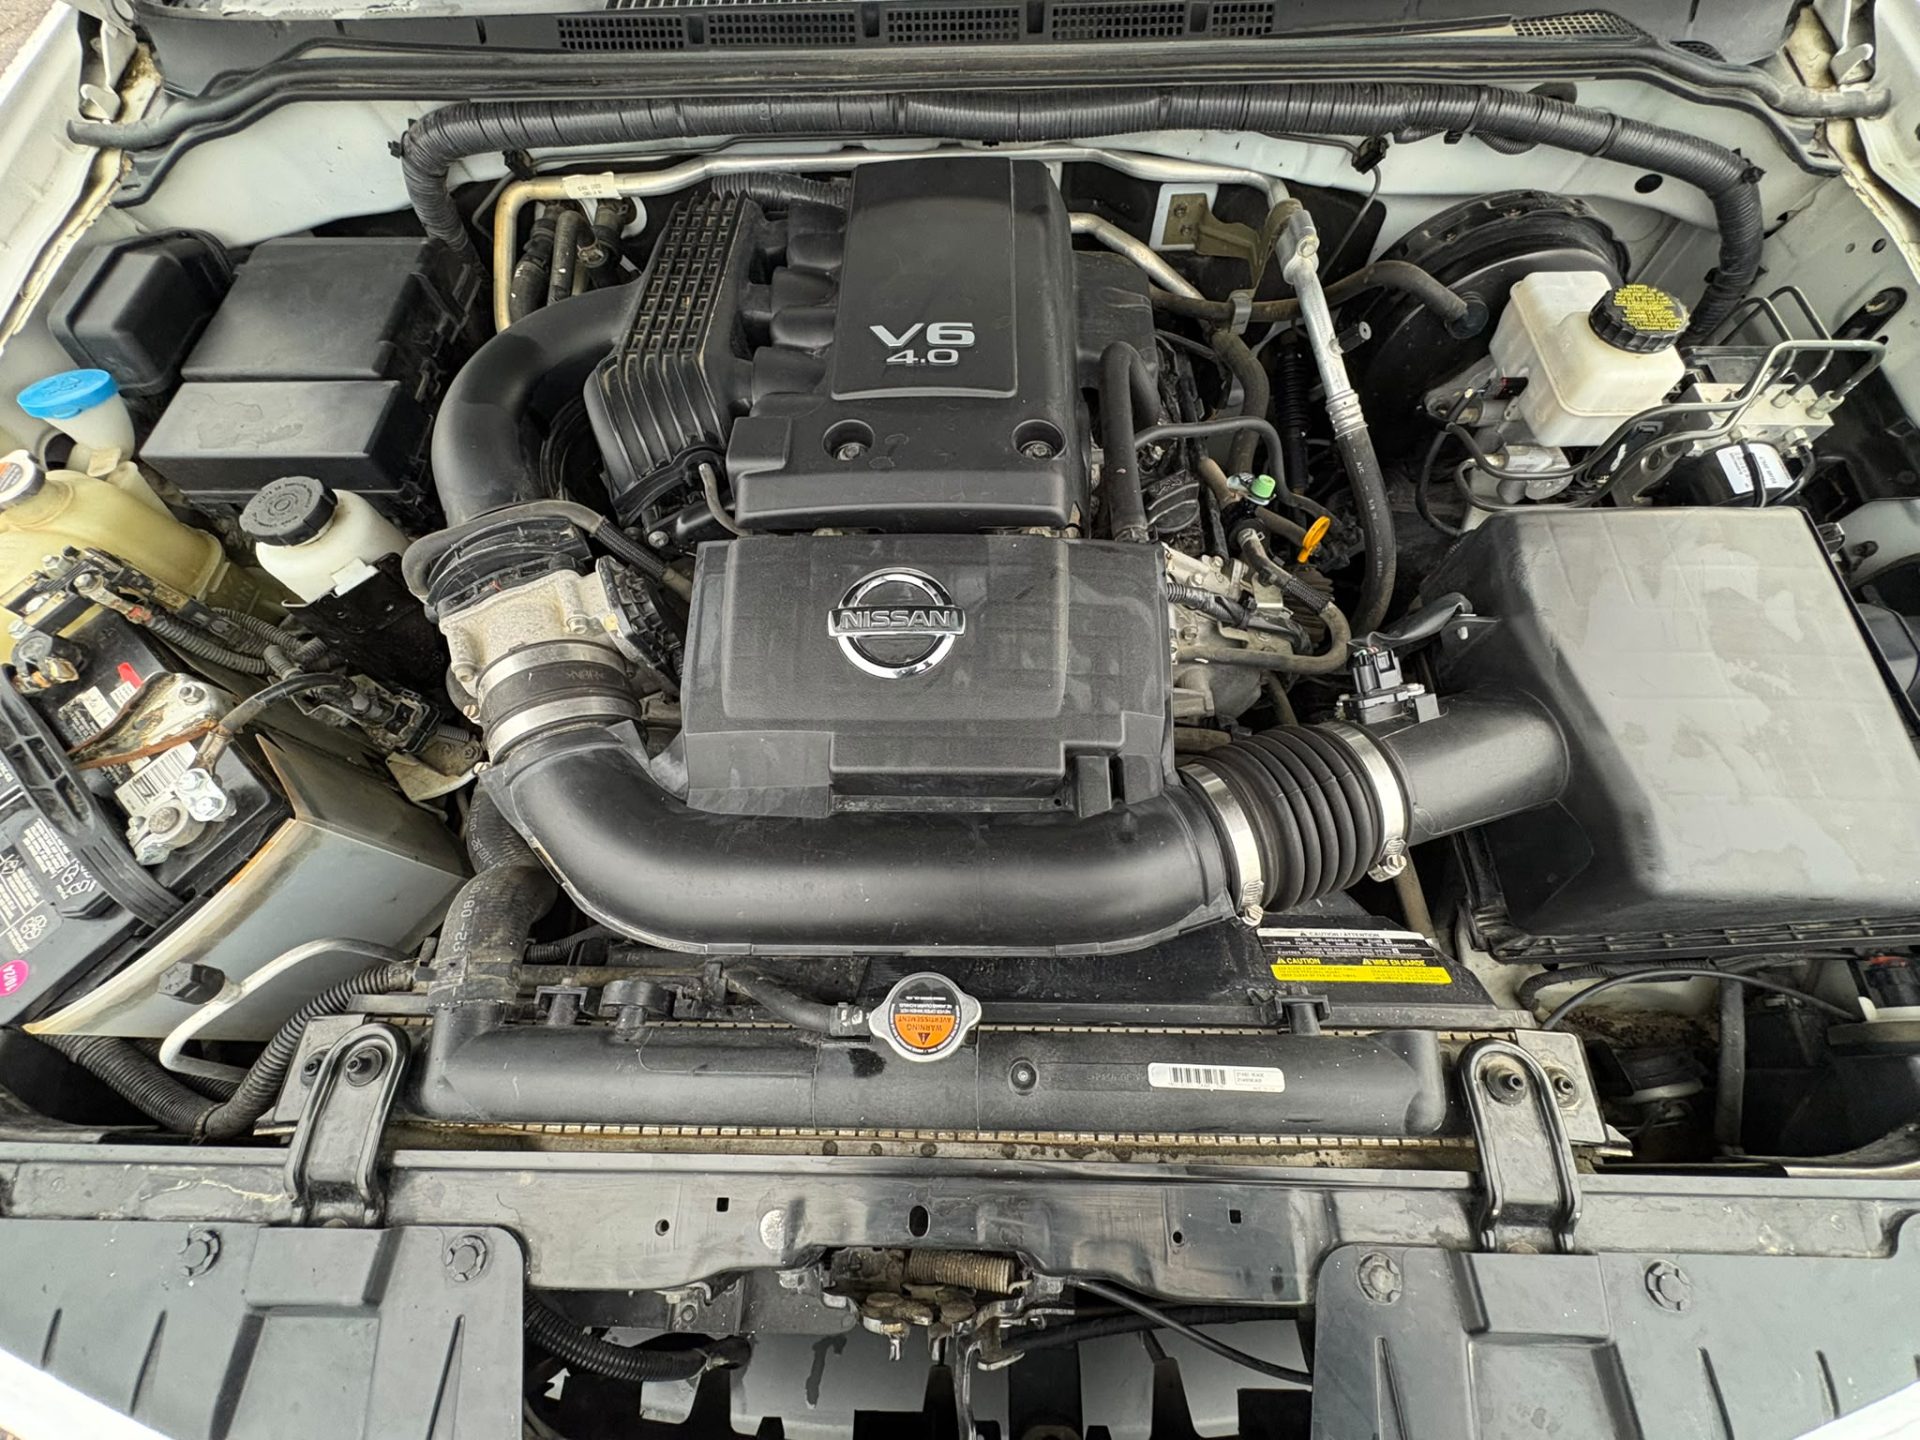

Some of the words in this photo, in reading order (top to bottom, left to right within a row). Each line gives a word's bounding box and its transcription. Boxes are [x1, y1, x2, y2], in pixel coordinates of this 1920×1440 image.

[869, 322, 976, 347] V6
[886, 348, 959, 366] 4.0
[841, 609, 951, 629] NISSAN
[1286, 957, 1321, 965] CAUTION
[2, 964, 18, 992] 10/24
[906, 1023, 943, 1031] WARNING
